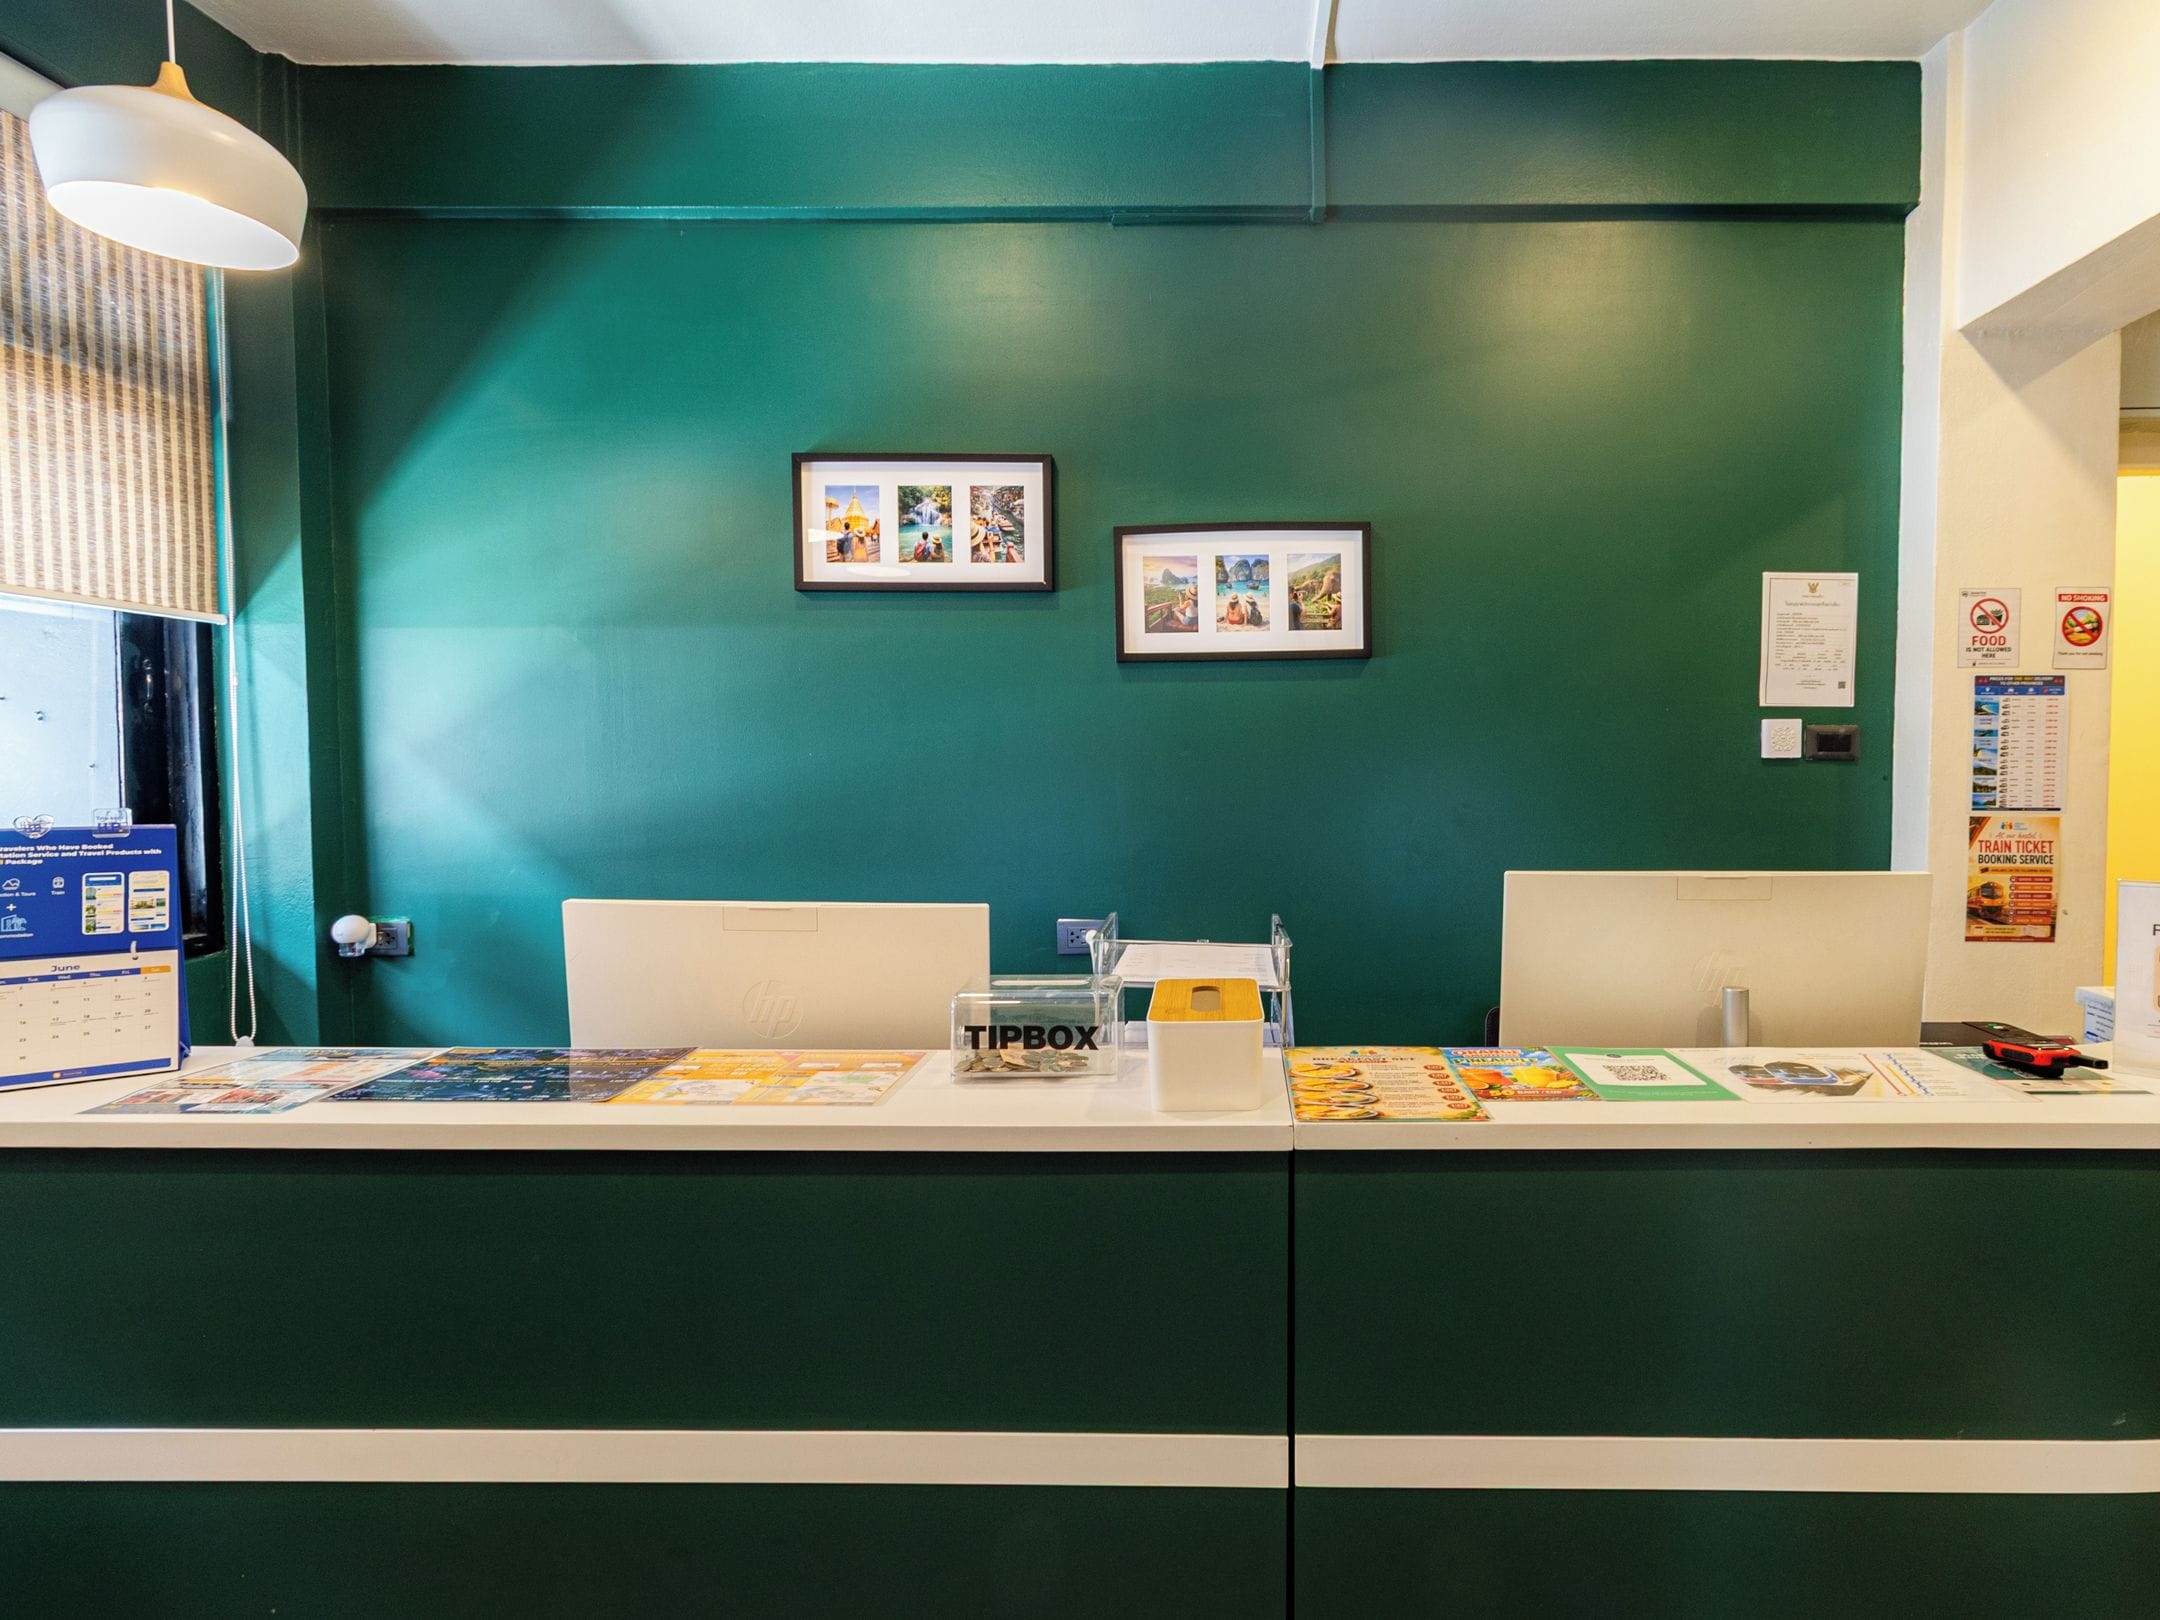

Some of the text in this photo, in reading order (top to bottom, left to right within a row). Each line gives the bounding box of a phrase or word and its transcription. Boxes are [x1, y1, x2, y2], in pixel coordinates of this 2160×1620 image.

[1972, 635, 2006, 646] FOOD
[1978, 840, 2054, 853] TRAIN TICKET
[28, 850, 59, 858] Service
[106, 848, 142, 856] Products
[5, 858, 43, 866] Package
[1978, 854, 2054, 865] BOOKING SERVICE
[51, 964, 81, 973] June
[747, 979, 798, 1039] hp
[964, 1025, 1099, 1050] TIPBOX
